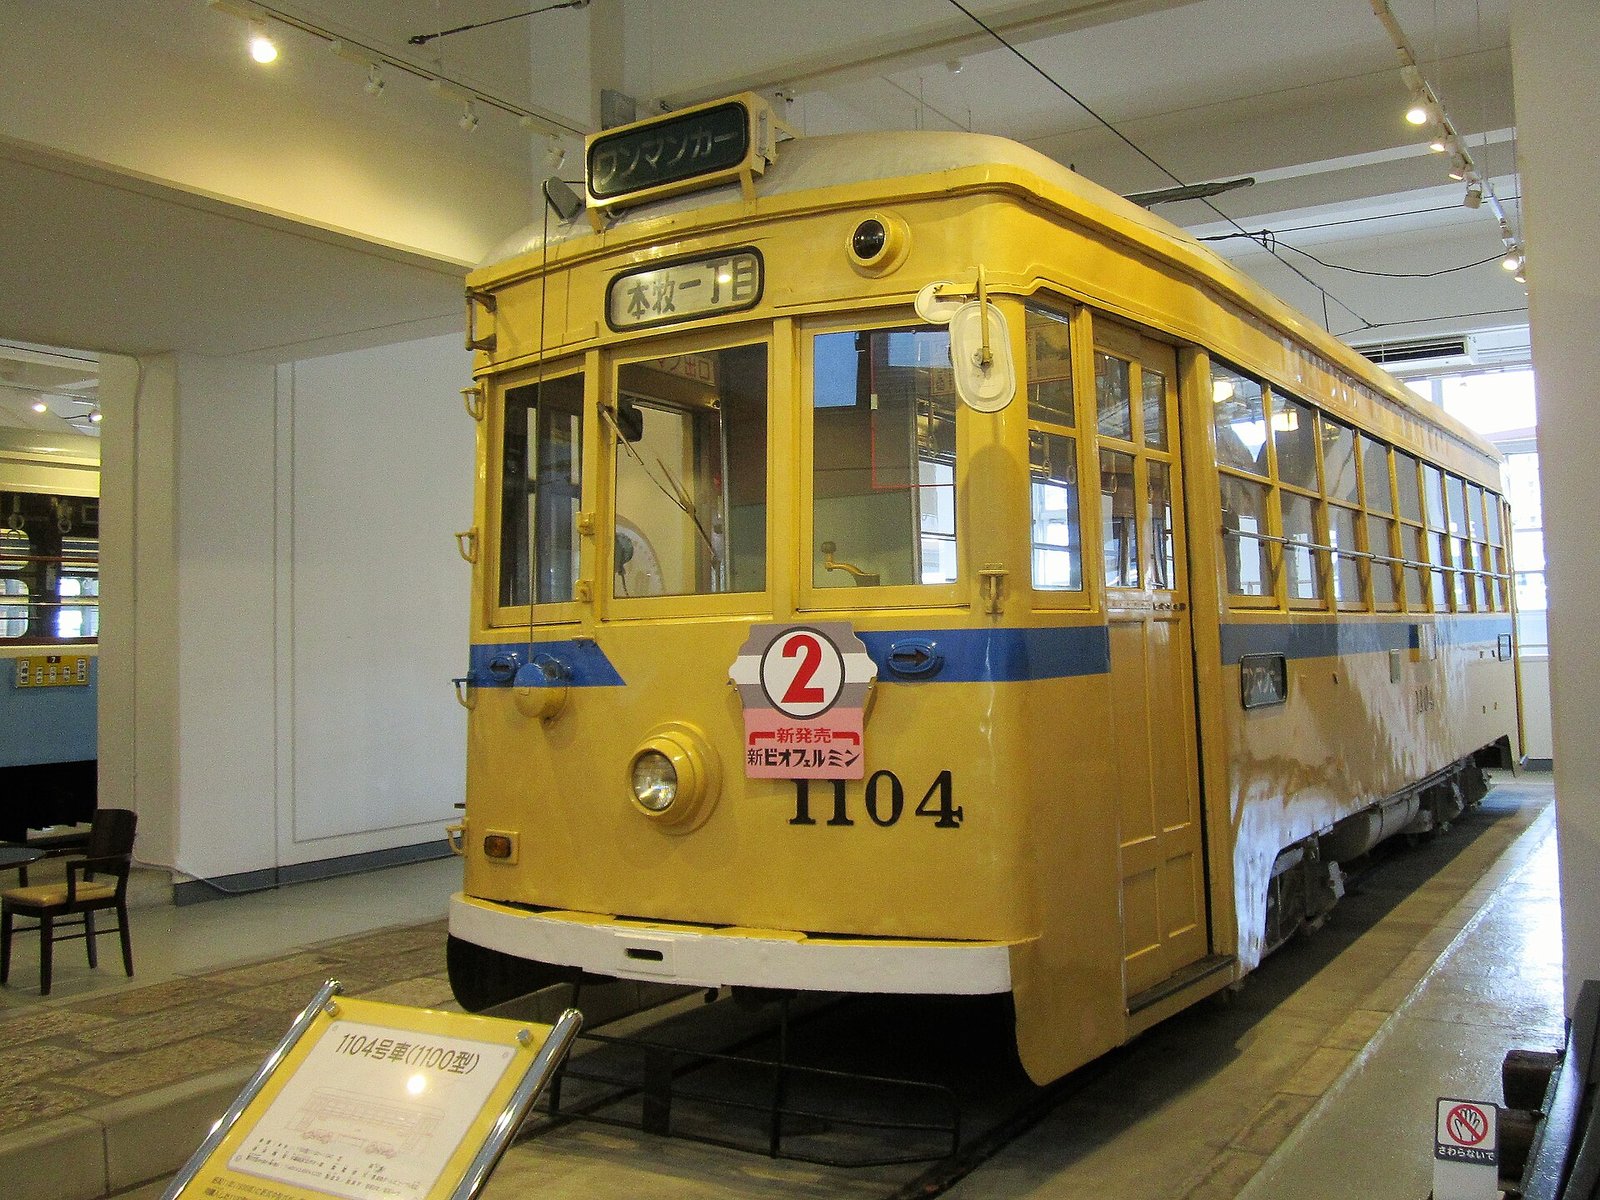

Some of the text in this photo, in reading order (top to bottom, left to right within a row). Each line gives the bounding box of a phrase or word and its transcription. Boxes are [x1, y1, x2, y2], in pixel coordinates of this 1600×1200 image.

[595, 129, 735, 185] ワンマンカー
[626, 256, 756, 320] 本牧一丁目
[780, 634, 825, 704] 2
[747, 747, 861, 768] 新ビオフェルミン
[776, 727, 832, 744] 新発売
[789, 769, 964, 829] 1104
[335, 1033, 480, 1075] 1104号車(1100型)
[1438, 1146, 1495, 1161] さわらないで
